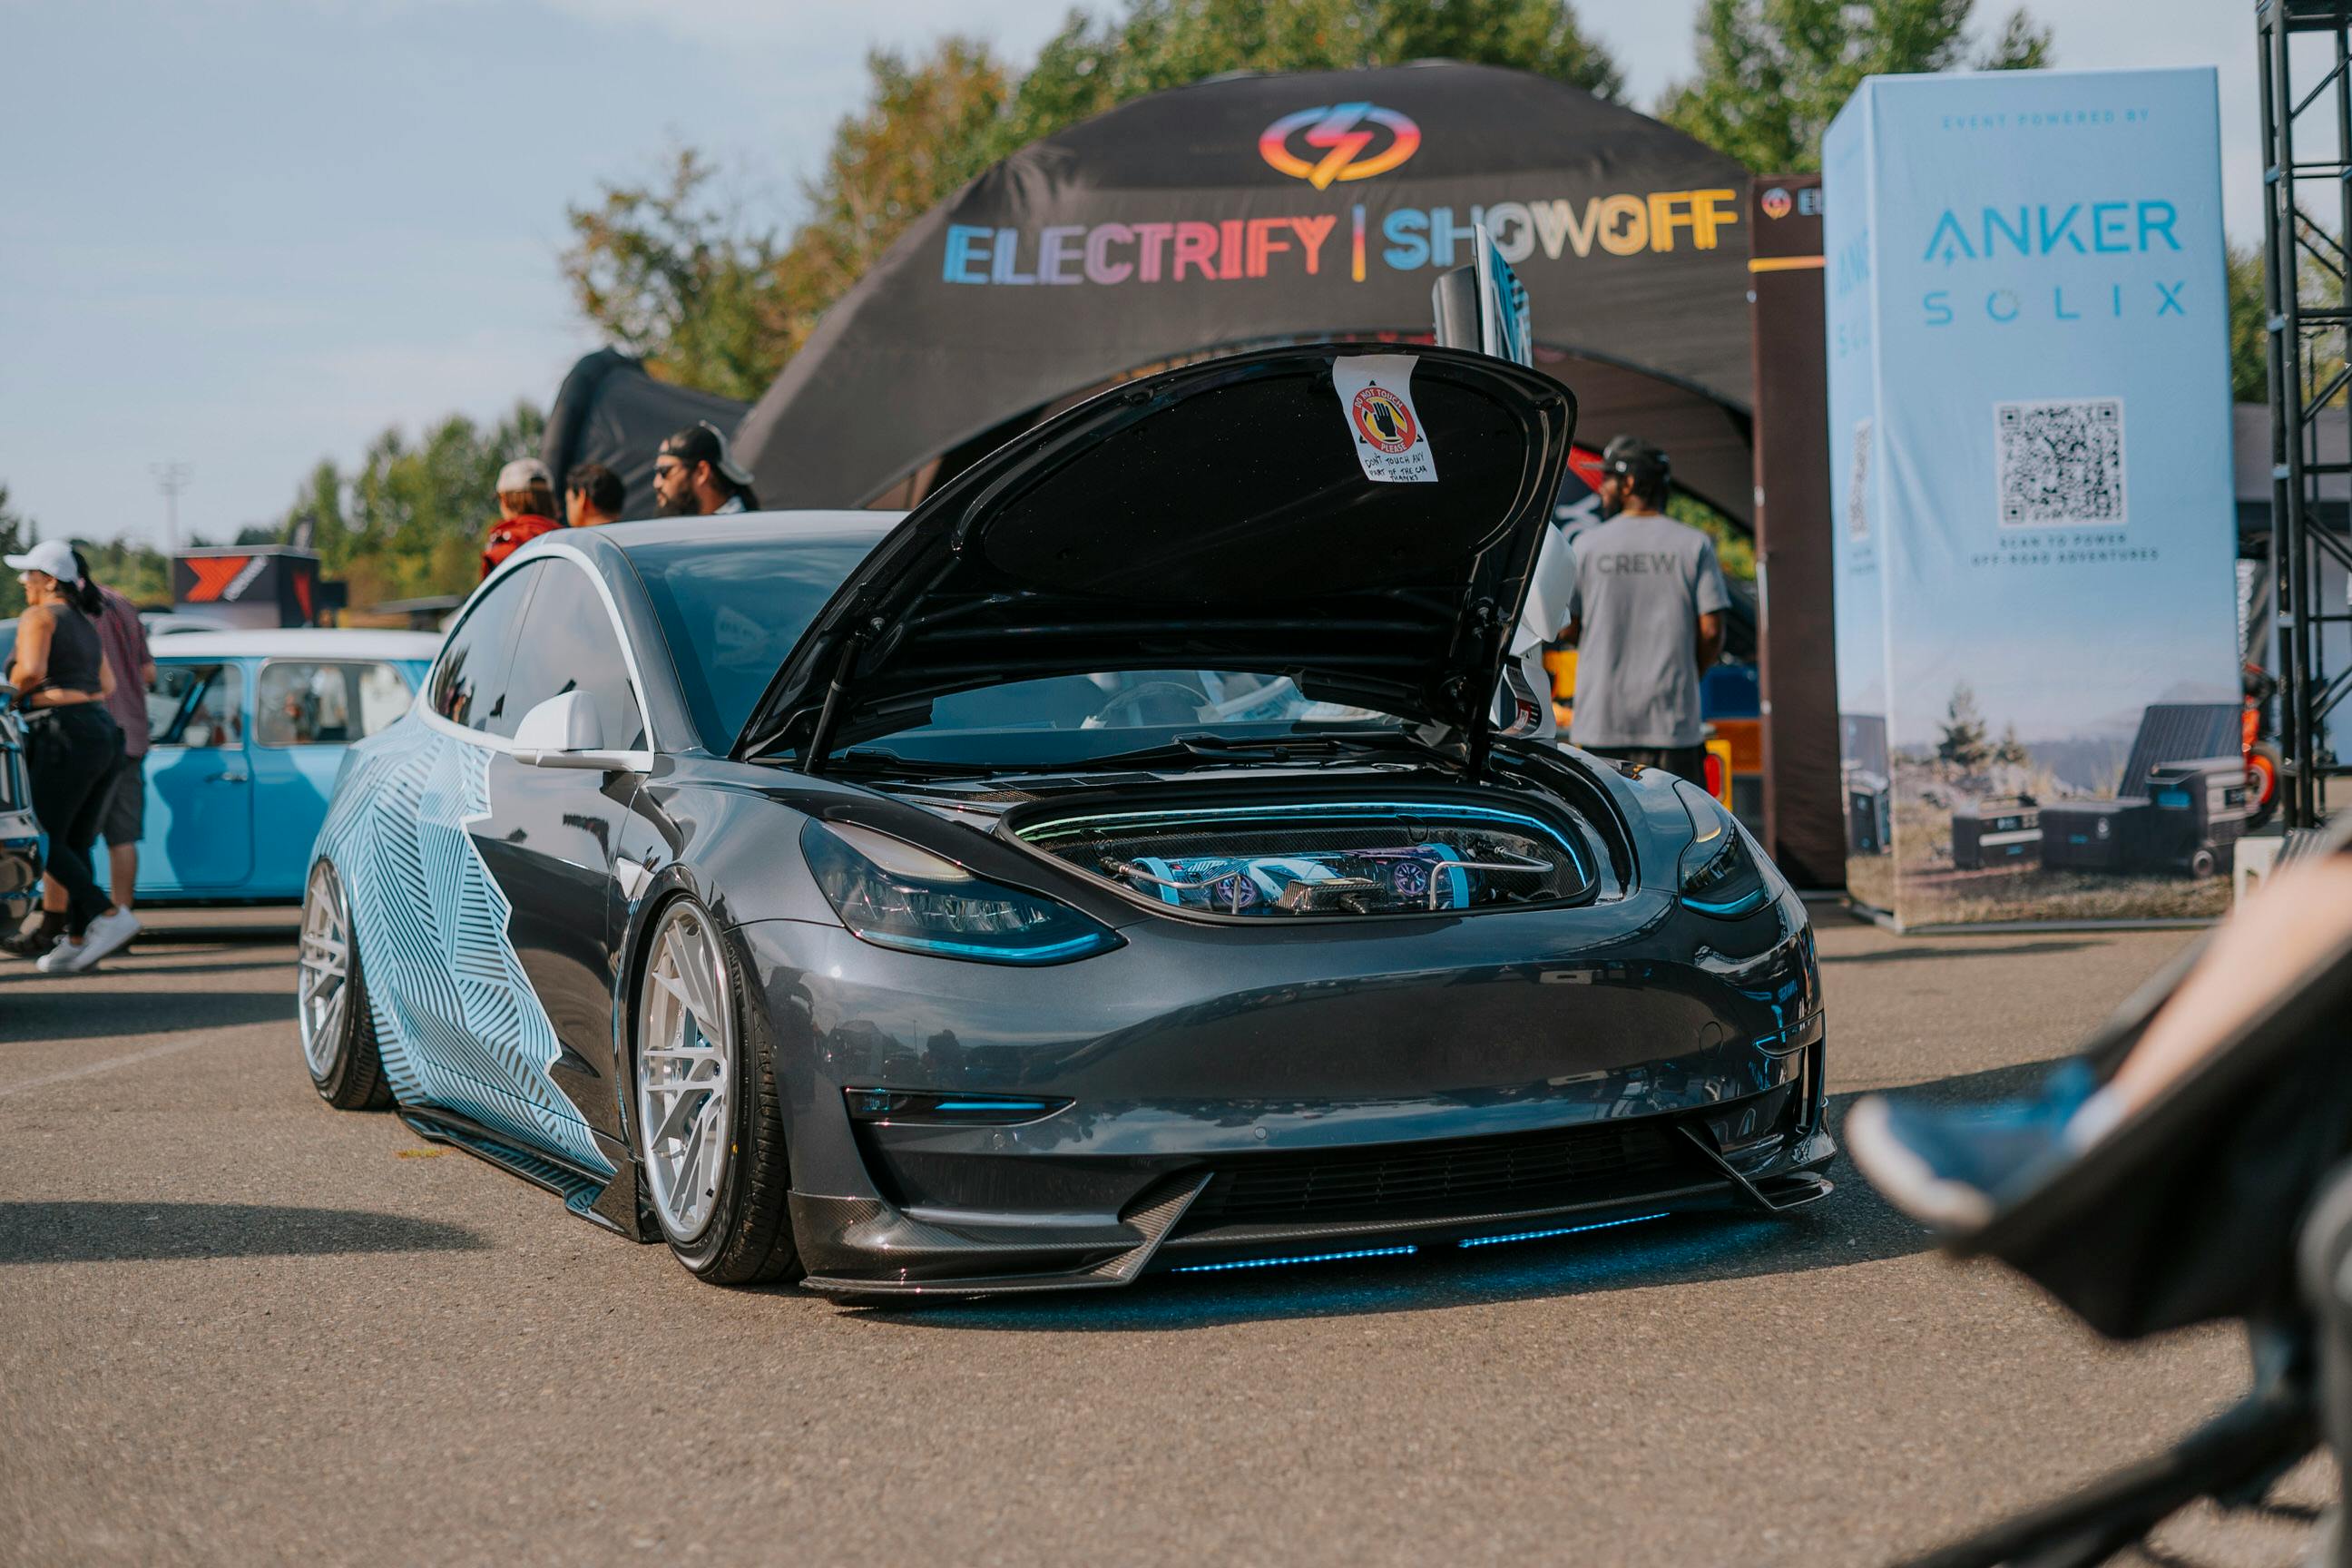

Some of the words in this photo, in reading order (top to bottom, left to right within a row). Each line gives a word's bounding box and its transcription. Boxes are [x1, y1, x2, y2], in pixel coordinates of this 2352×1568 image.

[1941, 114, 2006, 130] EVENT
[2016, 109, 2115, 125] POWERED
[2125, 108, 2150, 122] BY
[942, 214, 1338, 285] ELECTRIFY
[1383, 188, 1738, 270] SHOWOFF
[1923, 200, 2183, 263] ANKER
[1924, 281, 2187, 326] SOLIX
[1360, 389, 1375, 399] NOT
[1377, 389, 1403, 407] TOUCH
[1381, 443, 1407, 453] PLEASE
[1386, 456, 1410, 466] TOUCH
[1400, 466, 1413, 475] THE
[1596, 553, 1678, 575] CREW
